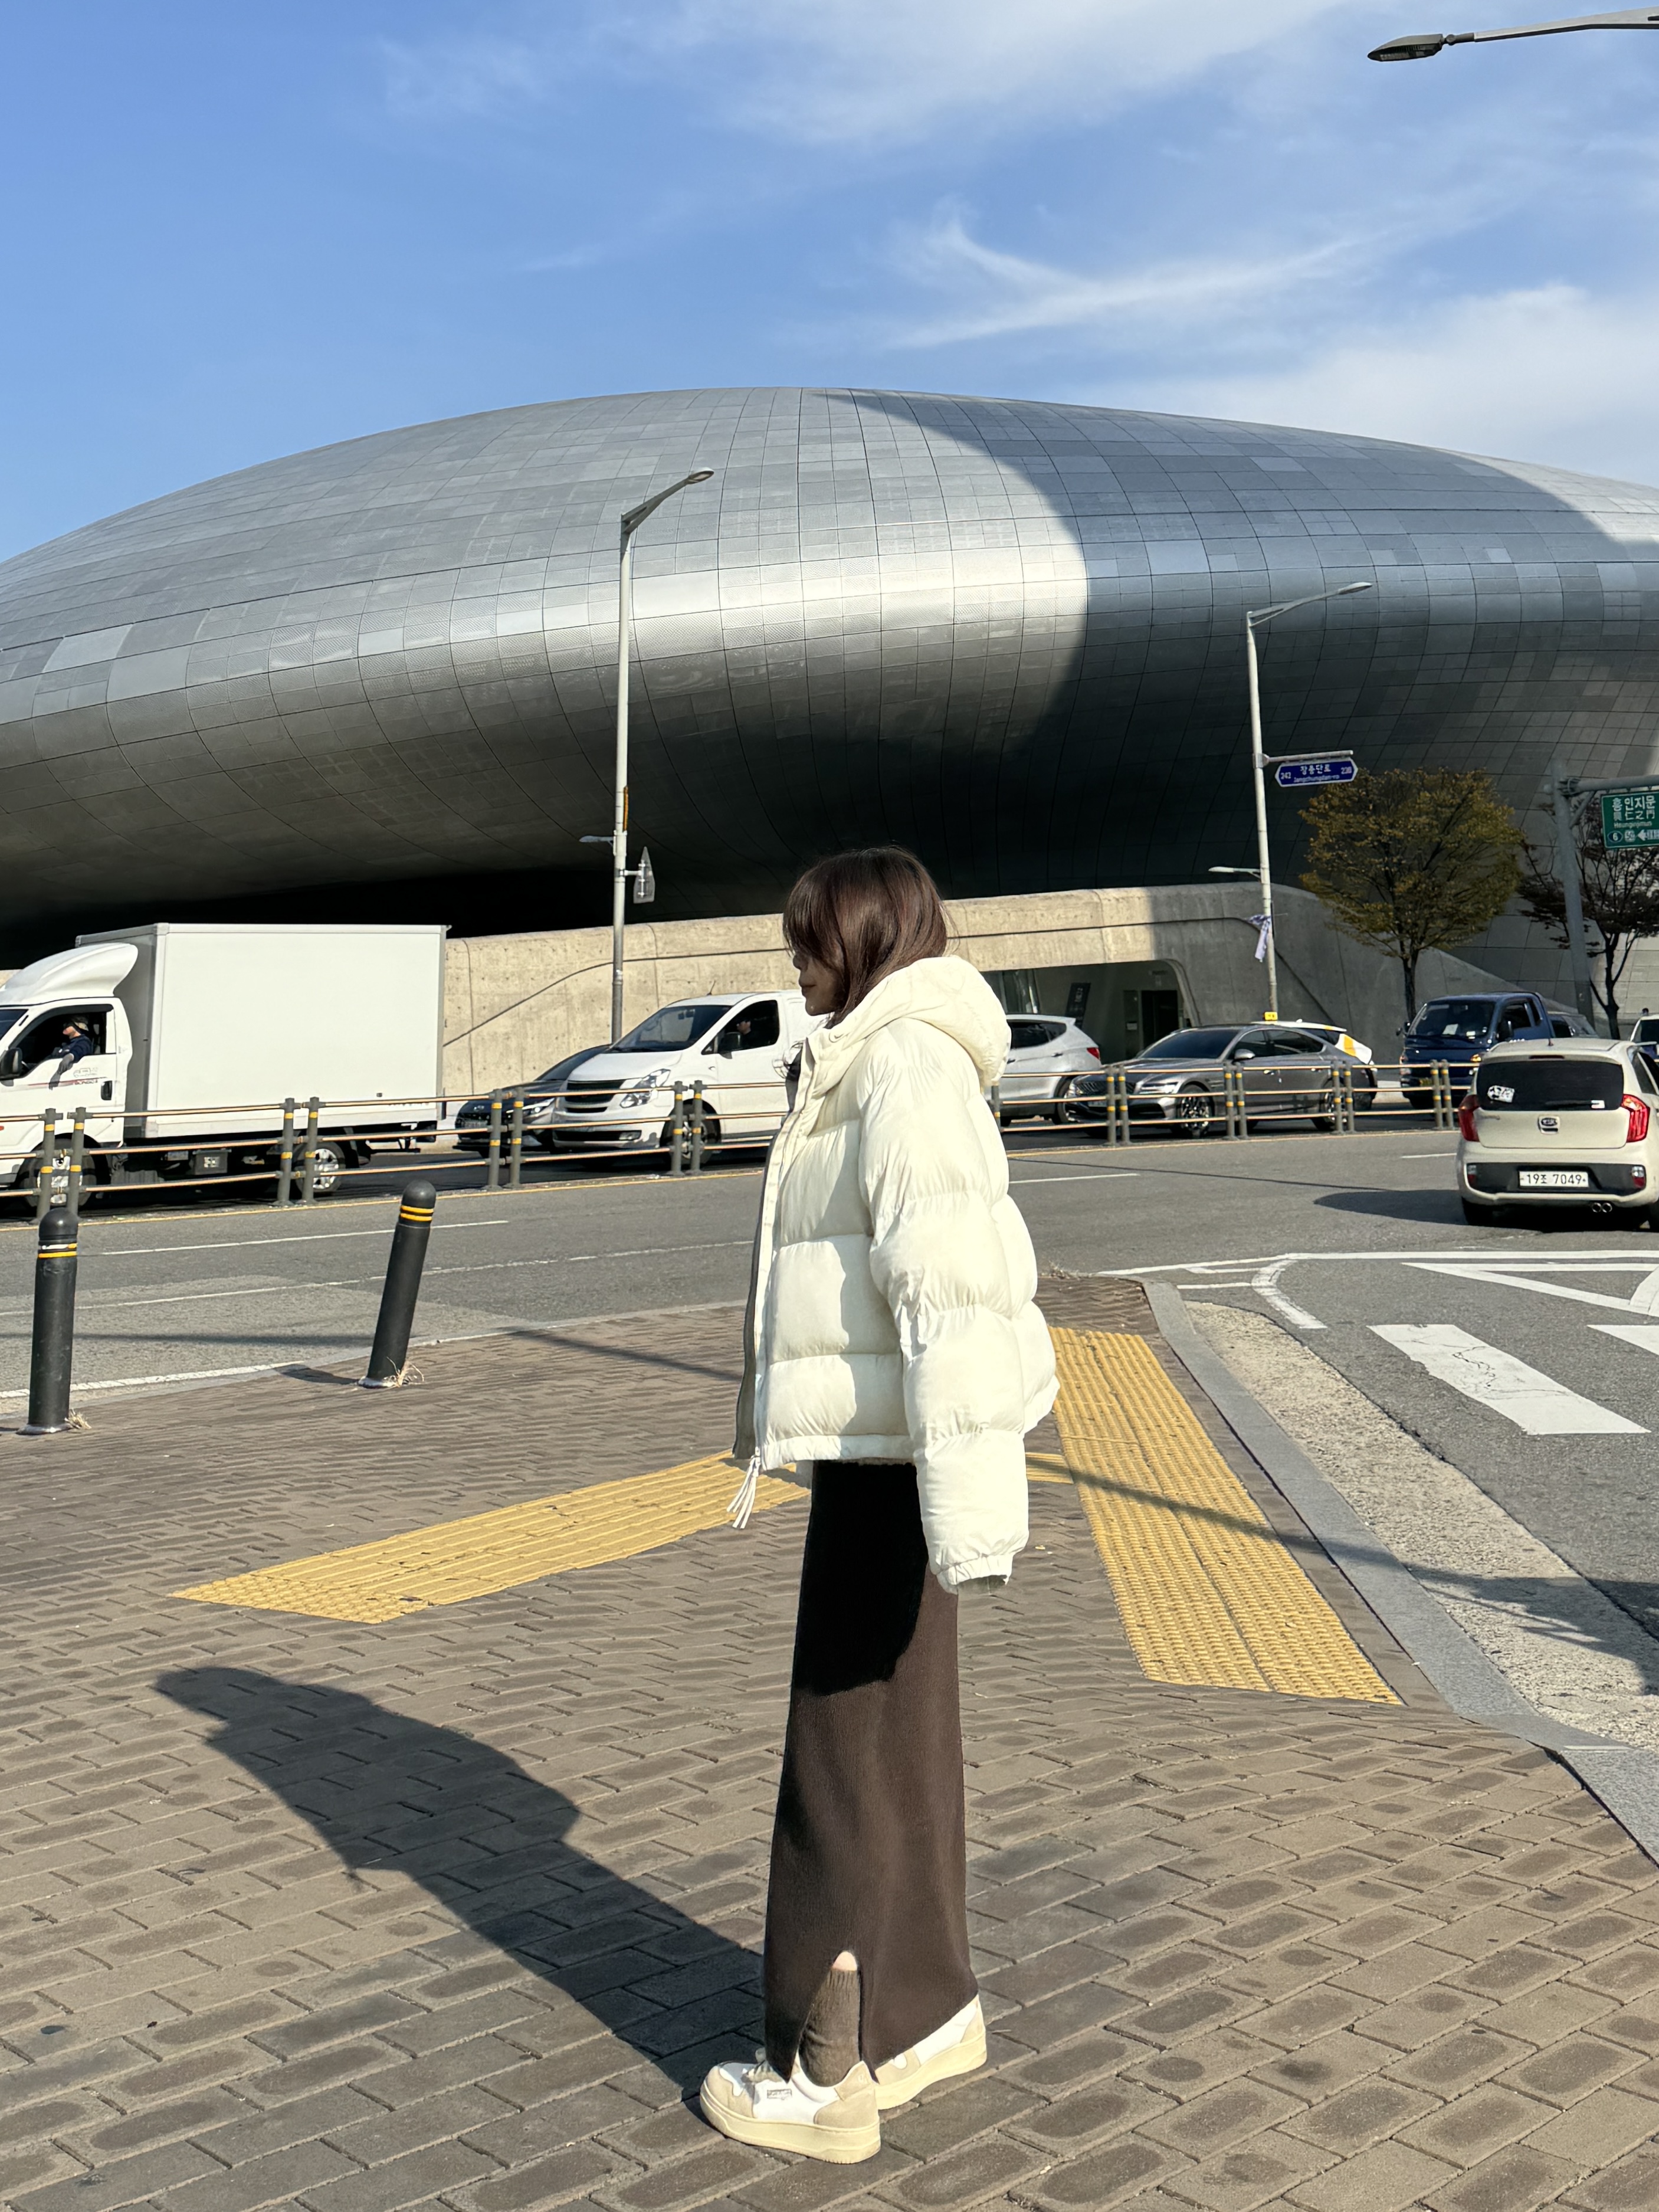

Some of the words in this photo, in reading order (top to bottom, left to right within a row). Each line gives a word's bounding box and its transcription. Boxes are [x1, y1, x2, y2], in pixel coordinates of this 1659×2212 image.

[1300, 764, 1332, 775] 장충단로
[1612, 795, 1656, 812] 흥인지문
[1612, 833, 1618, 841] 6
[1552, 1174, 1582, 1184] 7049
